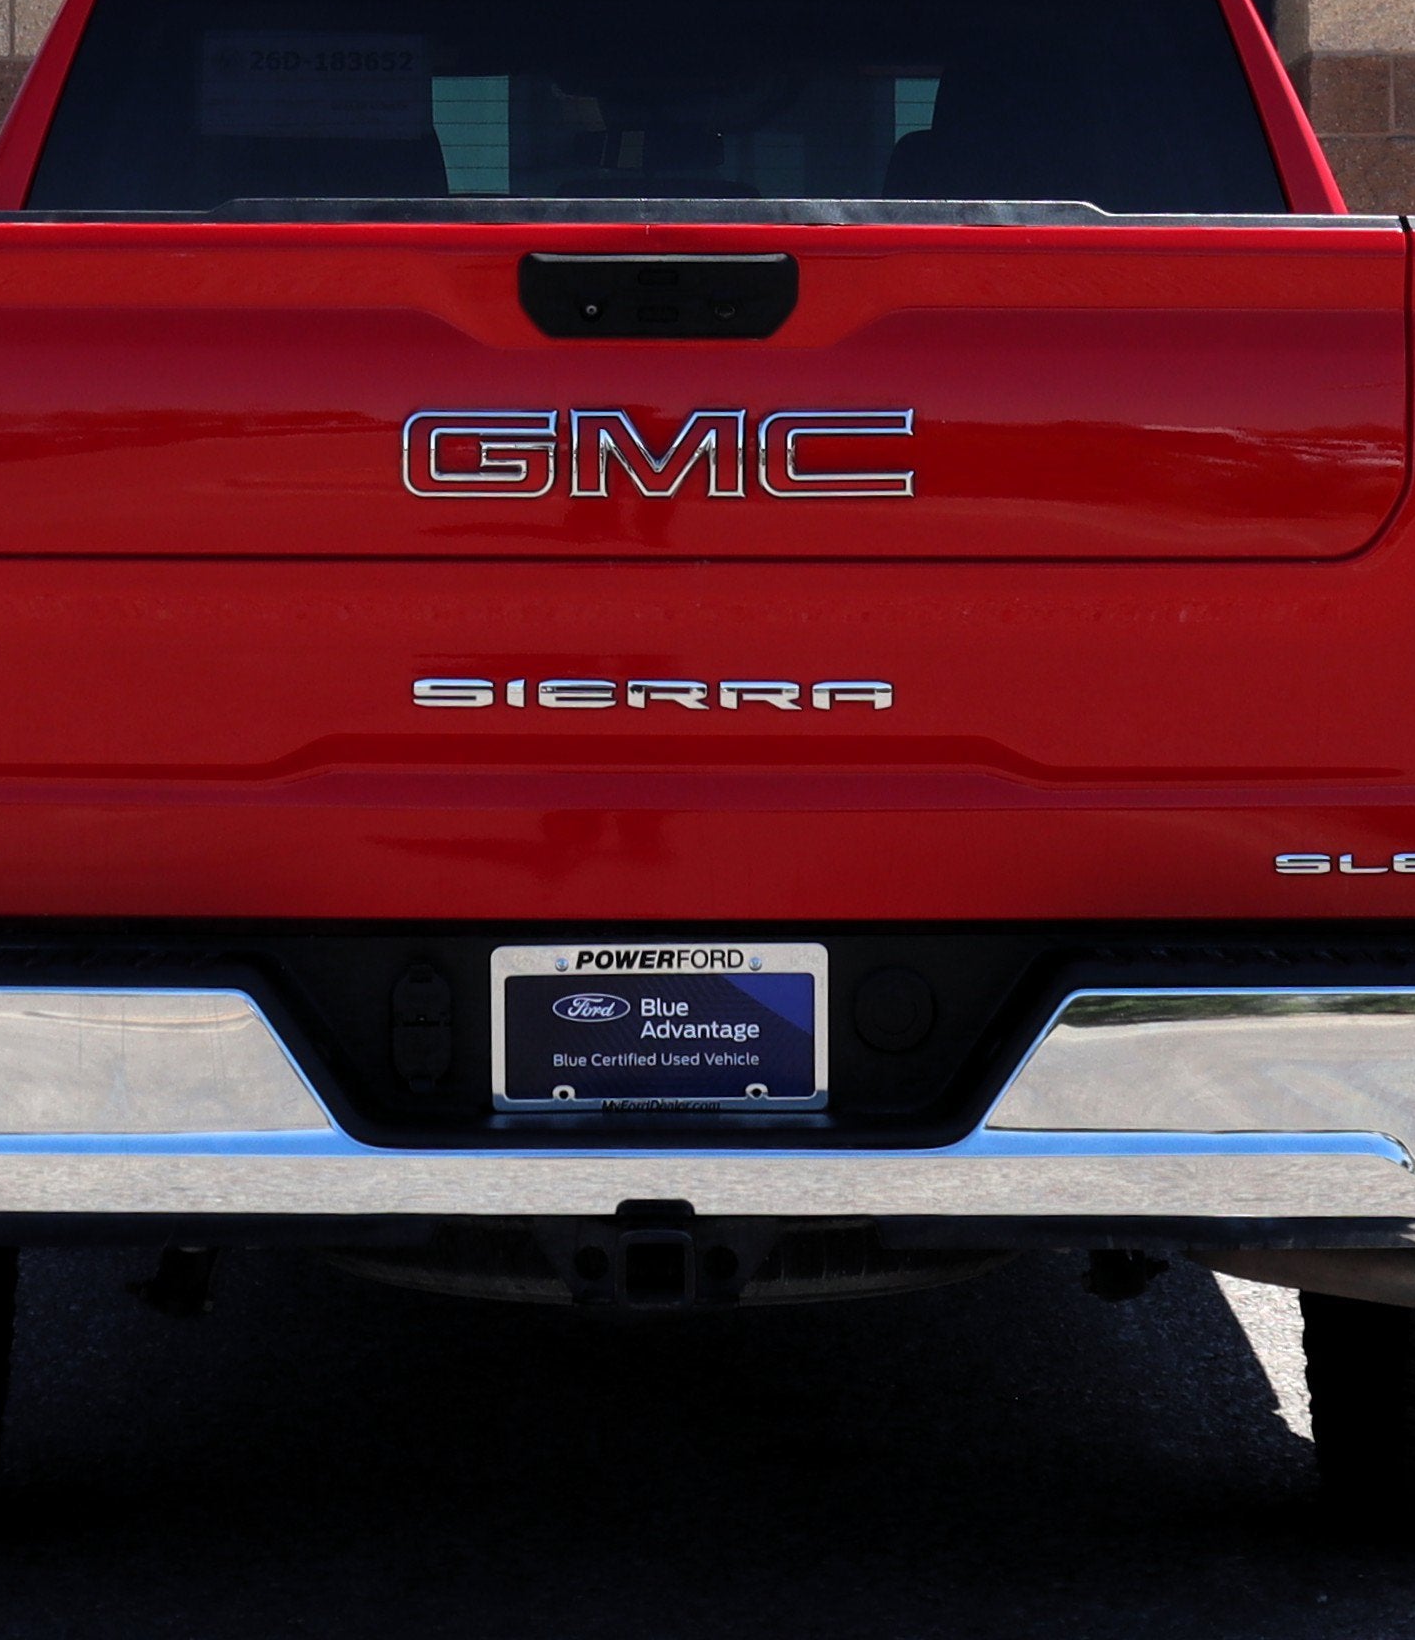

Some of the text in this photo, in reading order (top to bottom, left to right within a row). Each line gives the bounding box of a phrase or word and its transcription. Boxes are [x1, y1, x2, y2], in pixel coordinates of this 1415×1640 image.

[401, 408, 915, 498] GMC
[412, 677, 895, 712] SIERRA
[575, 949, 745, 970] POWERFORD
[566, 996, 616, 1019] Ford
[640, 997, 690, 1017] Blue
[640, 1019, 761, 1042] Advantage
[553, 1052, 760, 1068] Blue Certified Used Vehicle
